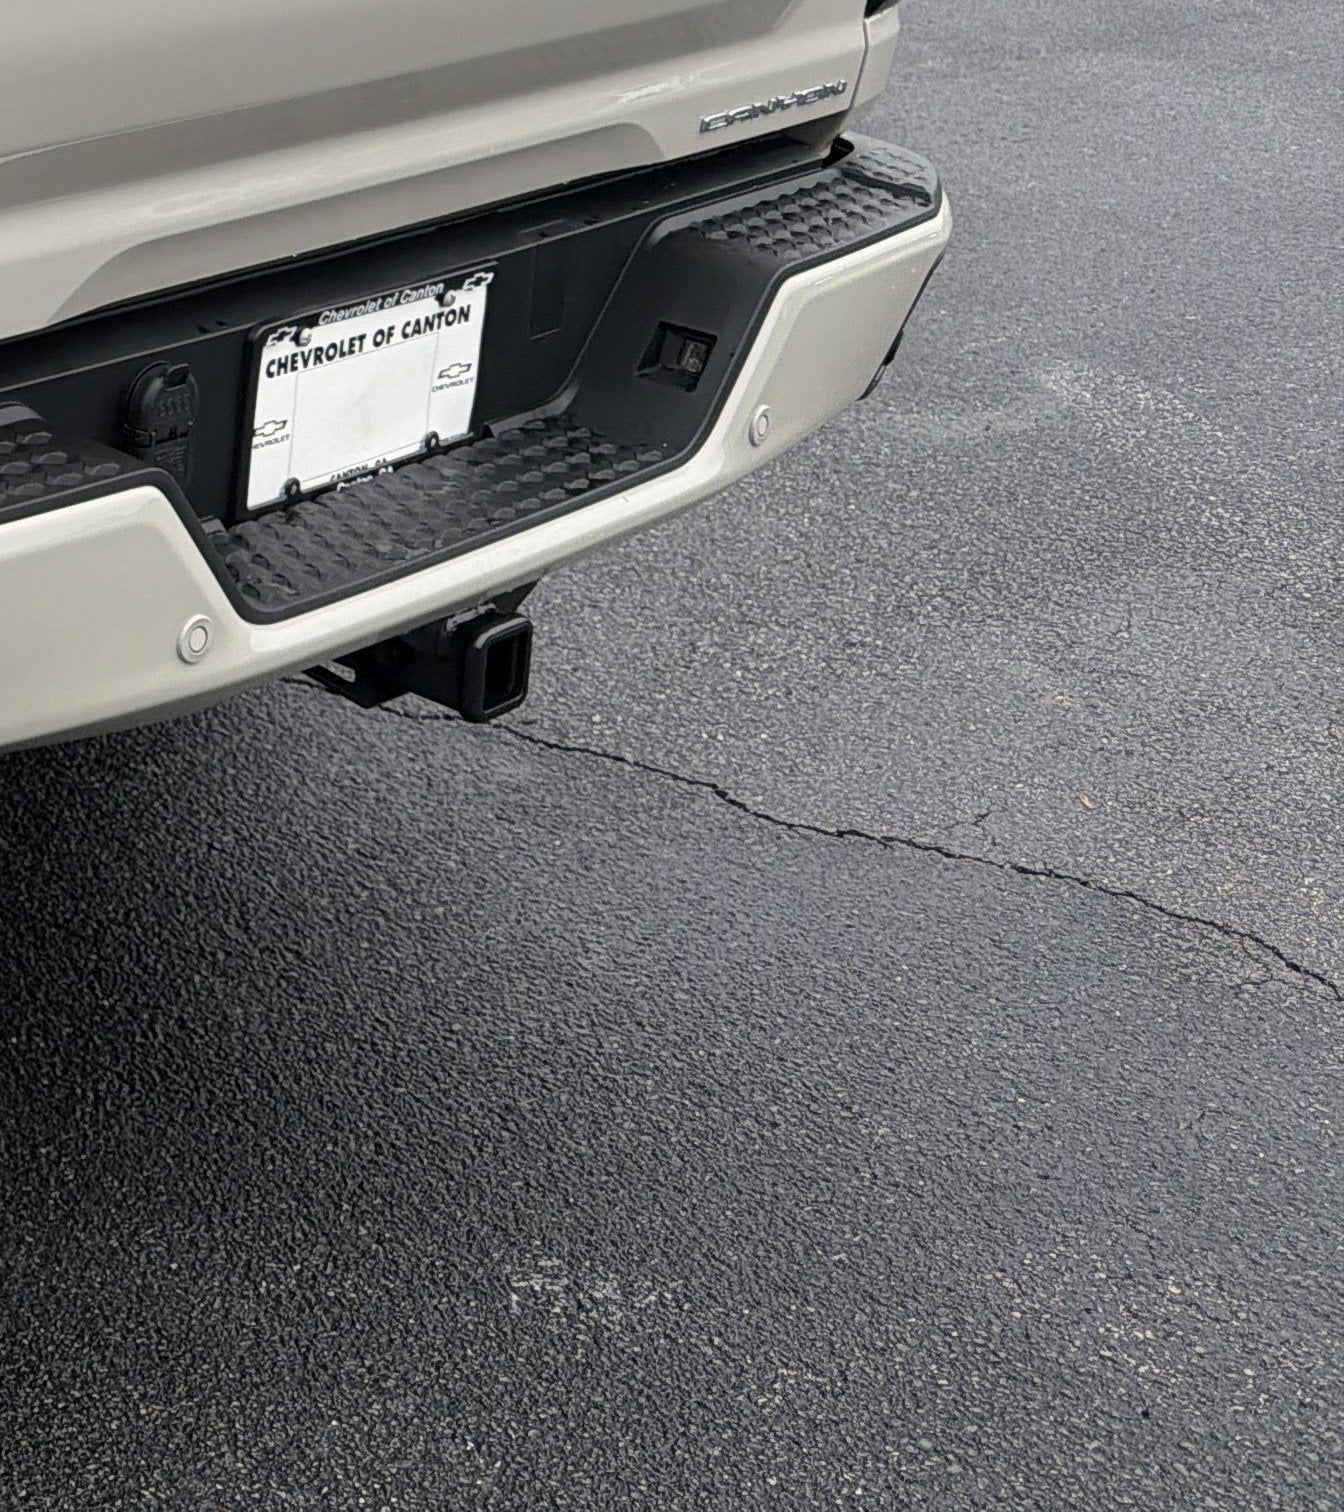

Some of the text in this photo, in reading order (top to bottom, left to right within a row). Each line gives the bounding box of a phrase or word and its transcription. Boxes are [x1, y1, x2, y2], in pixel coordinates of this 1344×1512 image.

[318, 282, 445, 326] Chevrolet of Canton
[266, 304, 471, 379] CHEVROLET OF CANTON
[431, 377, 474, 393] CHEVROLET
[253, 434, 290, 449] EVROLET
